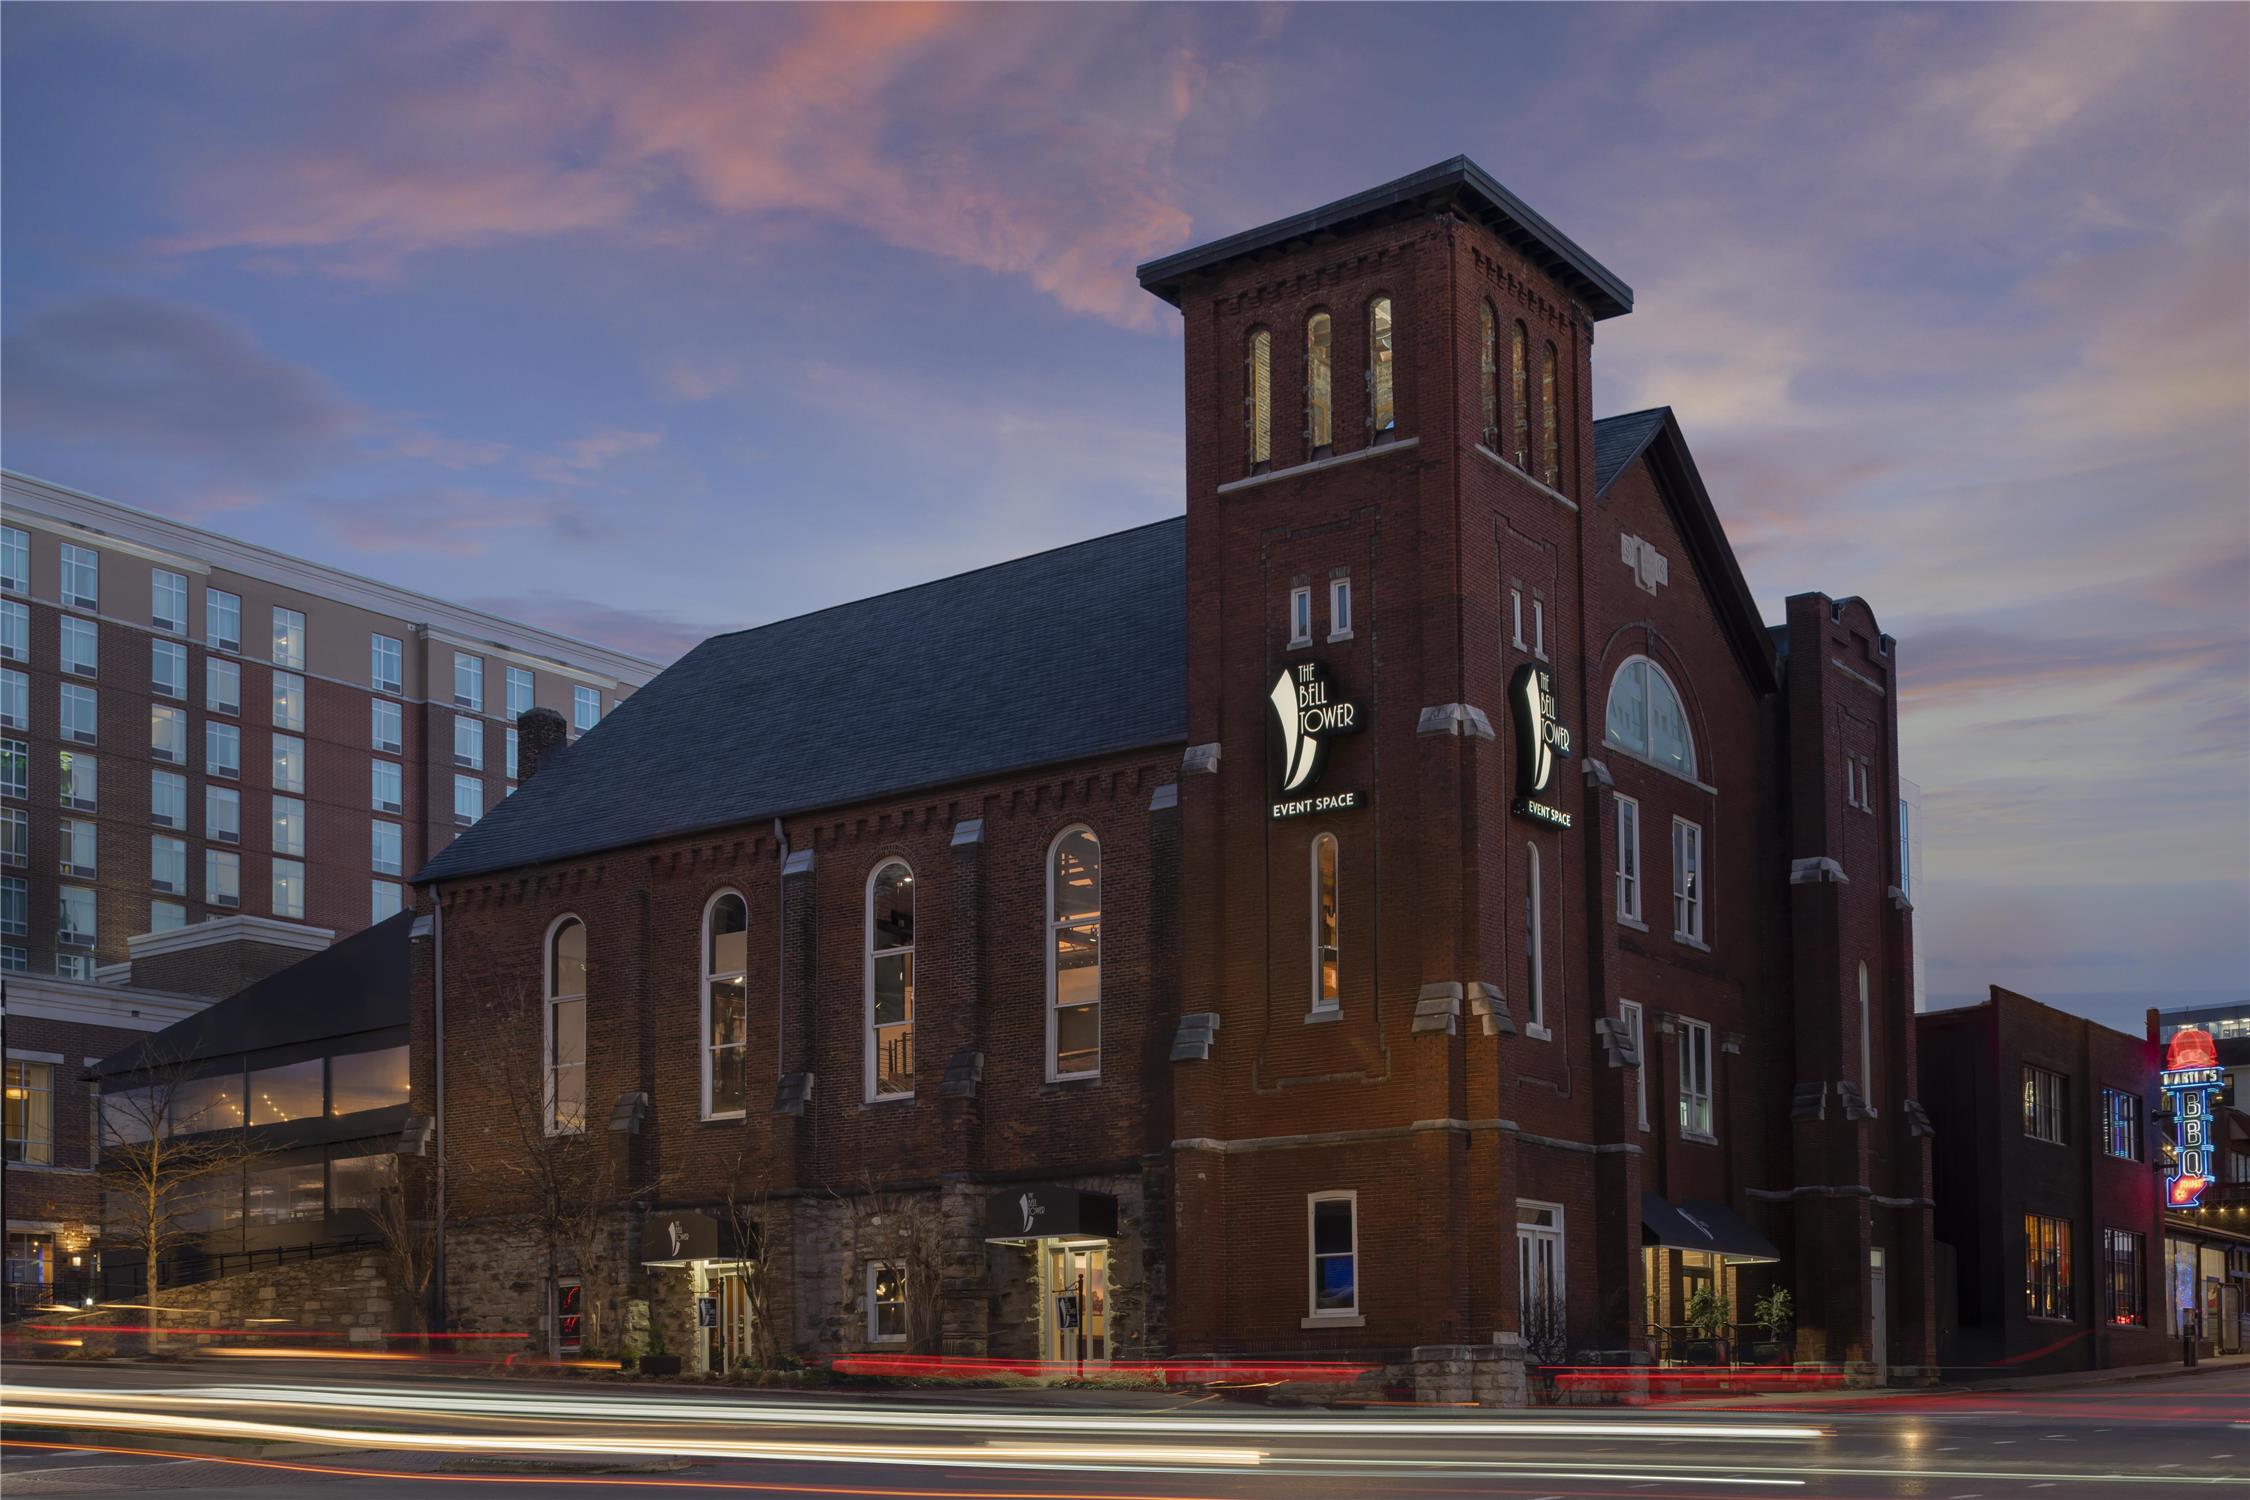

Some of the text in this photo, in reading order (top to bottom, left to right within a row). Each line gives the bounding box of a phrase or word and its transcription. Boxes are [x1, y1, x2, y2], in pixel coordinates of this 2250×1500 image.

[1298, 663, 1315, 682] THE
[1540, 672, 1550, 692] THE
[1299, 681, 1327, 708] BELL
[1540, 694, 1556, 720] BELL
[1299, 703, 1354, 734] TOWER
[1541, 718, 1570, 752] TOWER
[1273, 793, 1354, 817] EVENT SPACE
[1528, 801, 1571, 827] EVENT SPACE
[2182, 1091, 2203, 1178] BBQ
